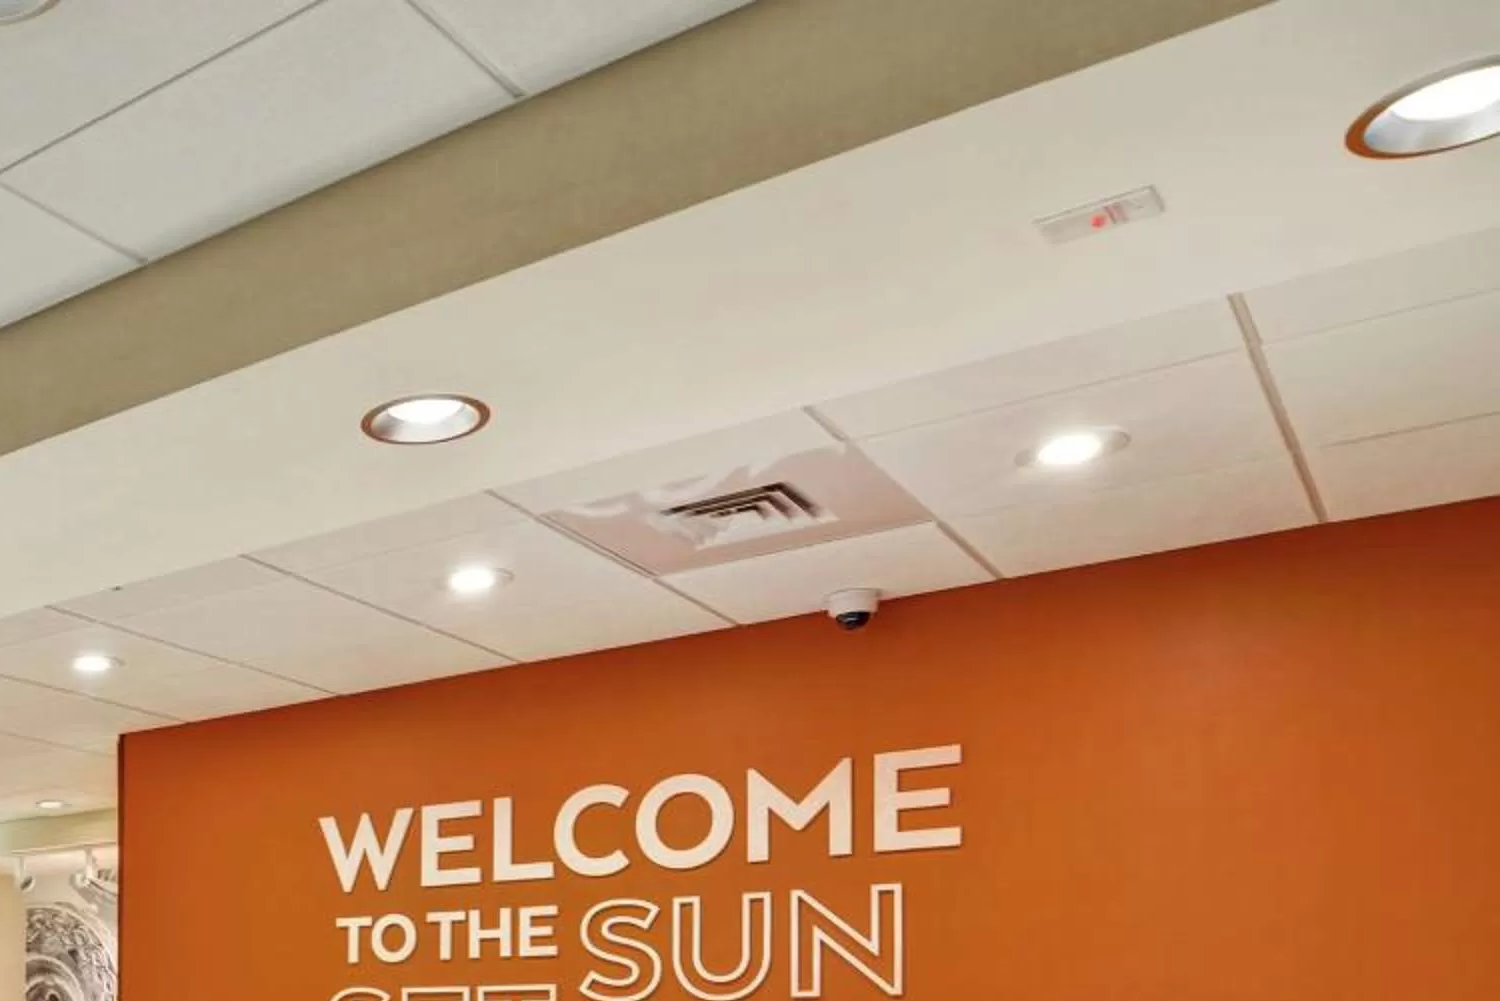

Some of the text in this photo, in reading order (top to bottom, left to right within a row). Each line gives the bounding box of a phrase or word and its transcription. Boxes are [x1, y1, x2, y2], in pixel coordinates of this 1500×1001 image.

[317, 743, 963, 894] WELCOME
[335, 912, 418, 964] TO
[426, 904, 559, 960] THE
